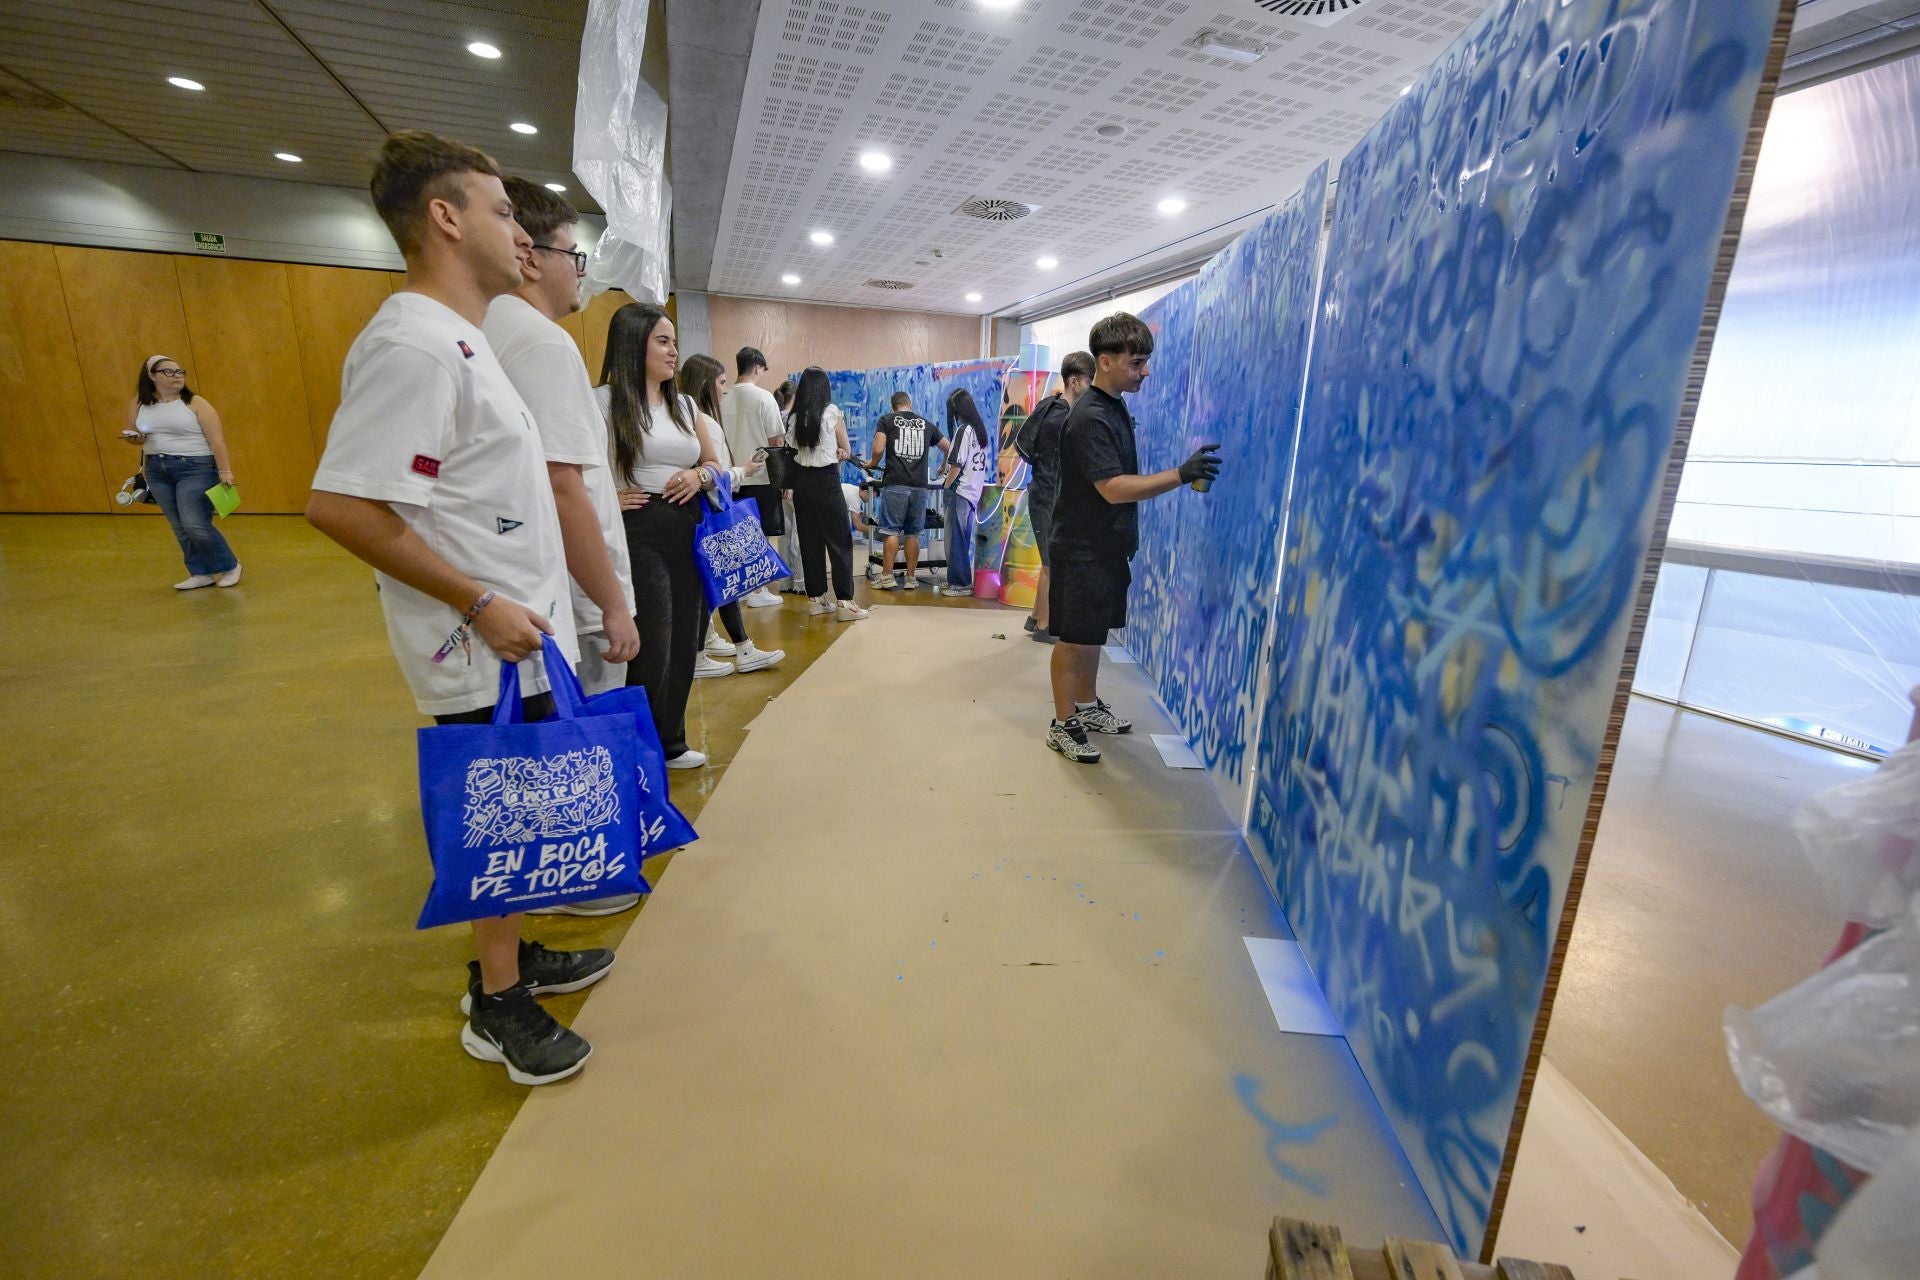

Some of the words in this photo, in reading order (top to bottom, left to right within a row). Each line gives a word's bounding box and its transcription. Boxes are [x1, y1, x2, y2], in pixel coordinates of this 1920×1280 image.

[894, 428, 925, 456] JAM
[725, 570, 740, 587] EN
[745, 556, 771, 578] BOCA
[722, 585, 739, 600] DE
[484, 846, 525, 874] EN
[538, 833, 608, 869] BOCA
[470, 874, 516, 901] DE
